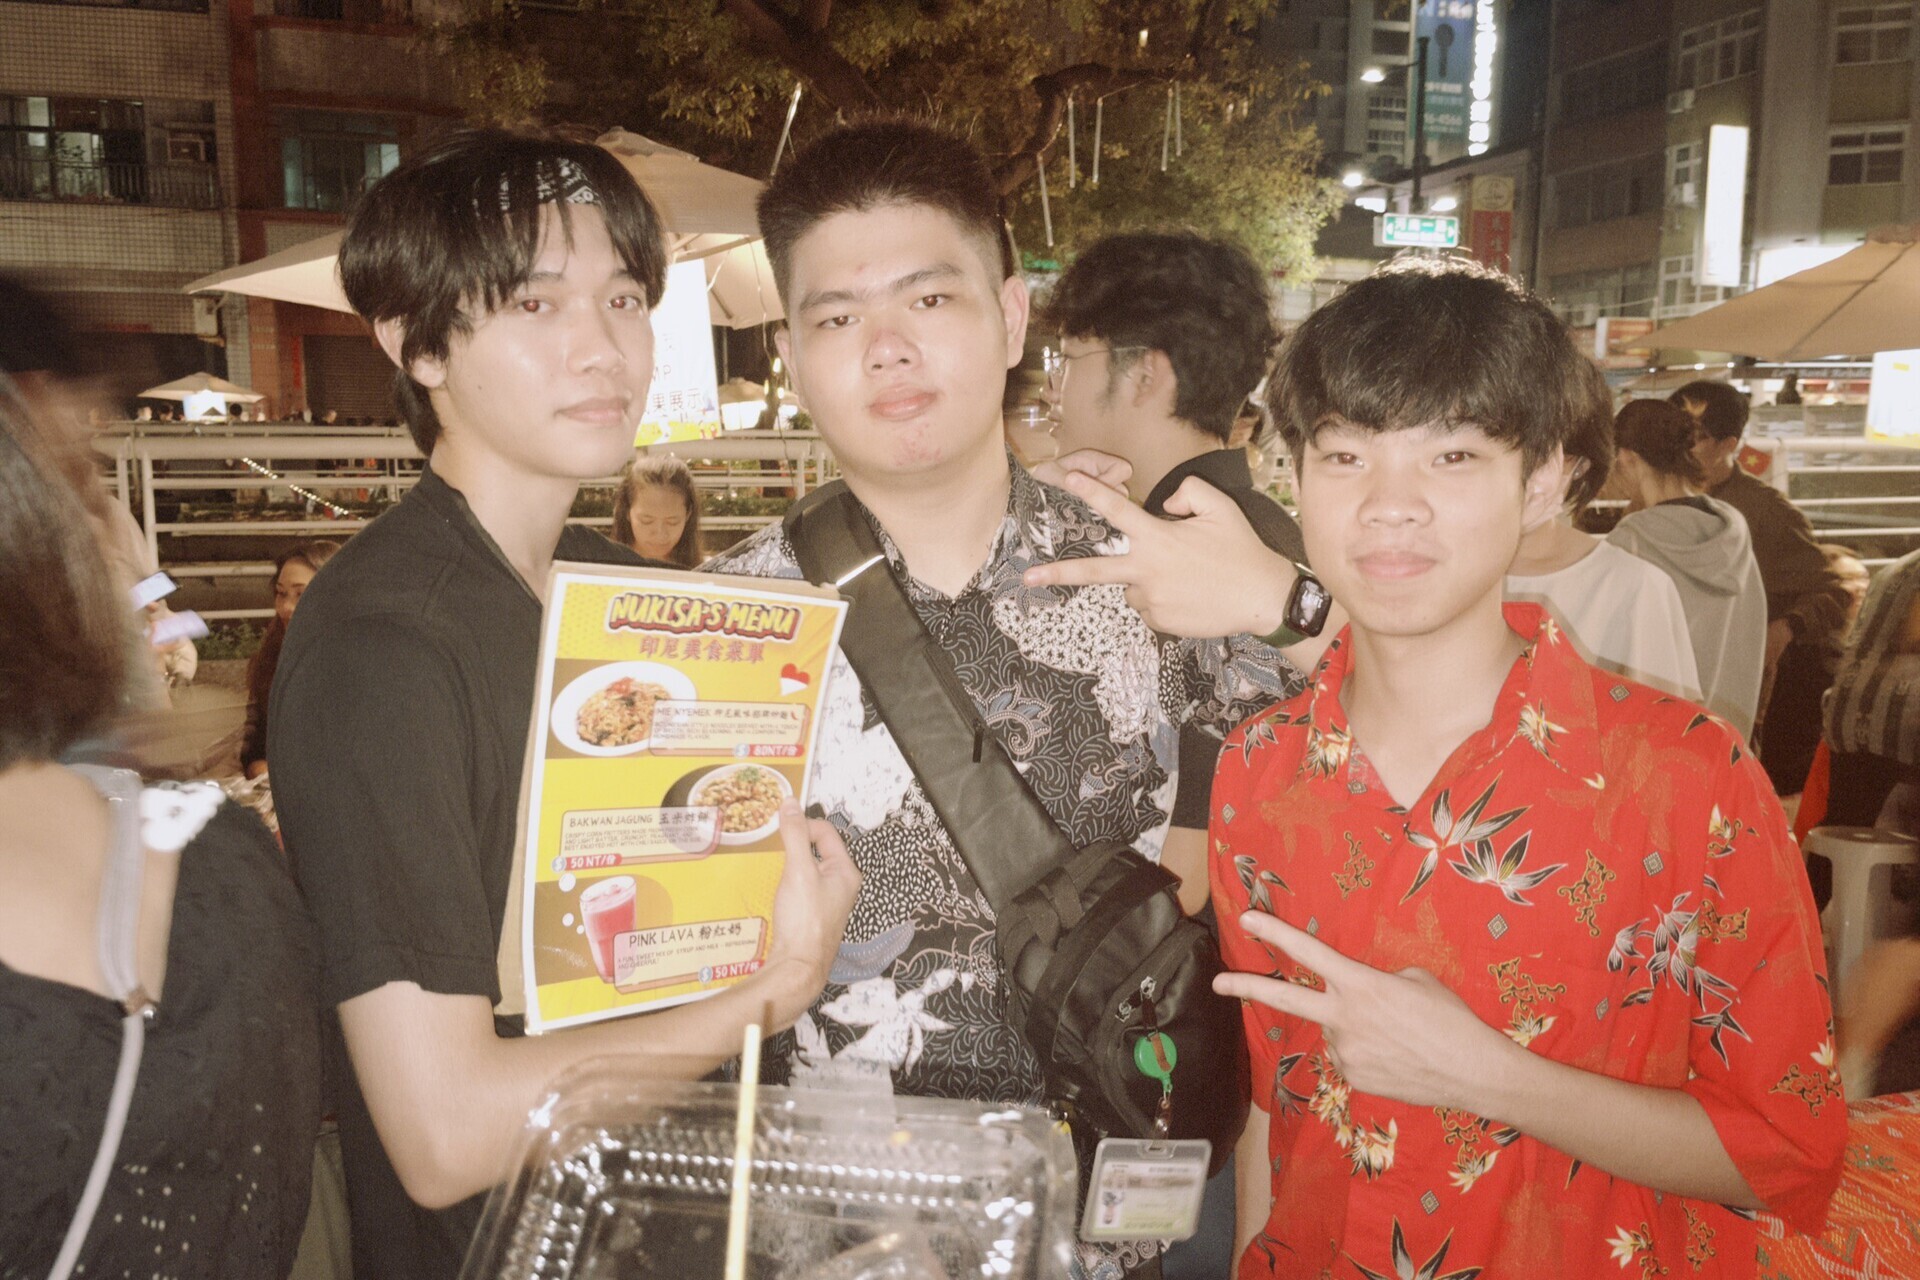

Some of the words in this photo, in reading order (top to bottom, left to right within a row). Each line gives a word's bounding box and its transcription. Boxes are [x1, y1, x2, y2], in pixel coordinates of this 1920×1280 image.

[609, 593, 727, 634] NUKISA'S
[724, 602, 800, 640] MENU
[639, 636, 765, 663] 印尼美食菜單
[569, 816, 613, 828] BAKWAN
[615, 814, 653, 825] JAGUNG
[570, 857, 583, 869] 50
[629, 931, 657, 948] PINK
[661, 927, 694, 944] LAVA
[698, 922, 742, 940] 粉紅奶
[714, 966, 728, 978] 50
